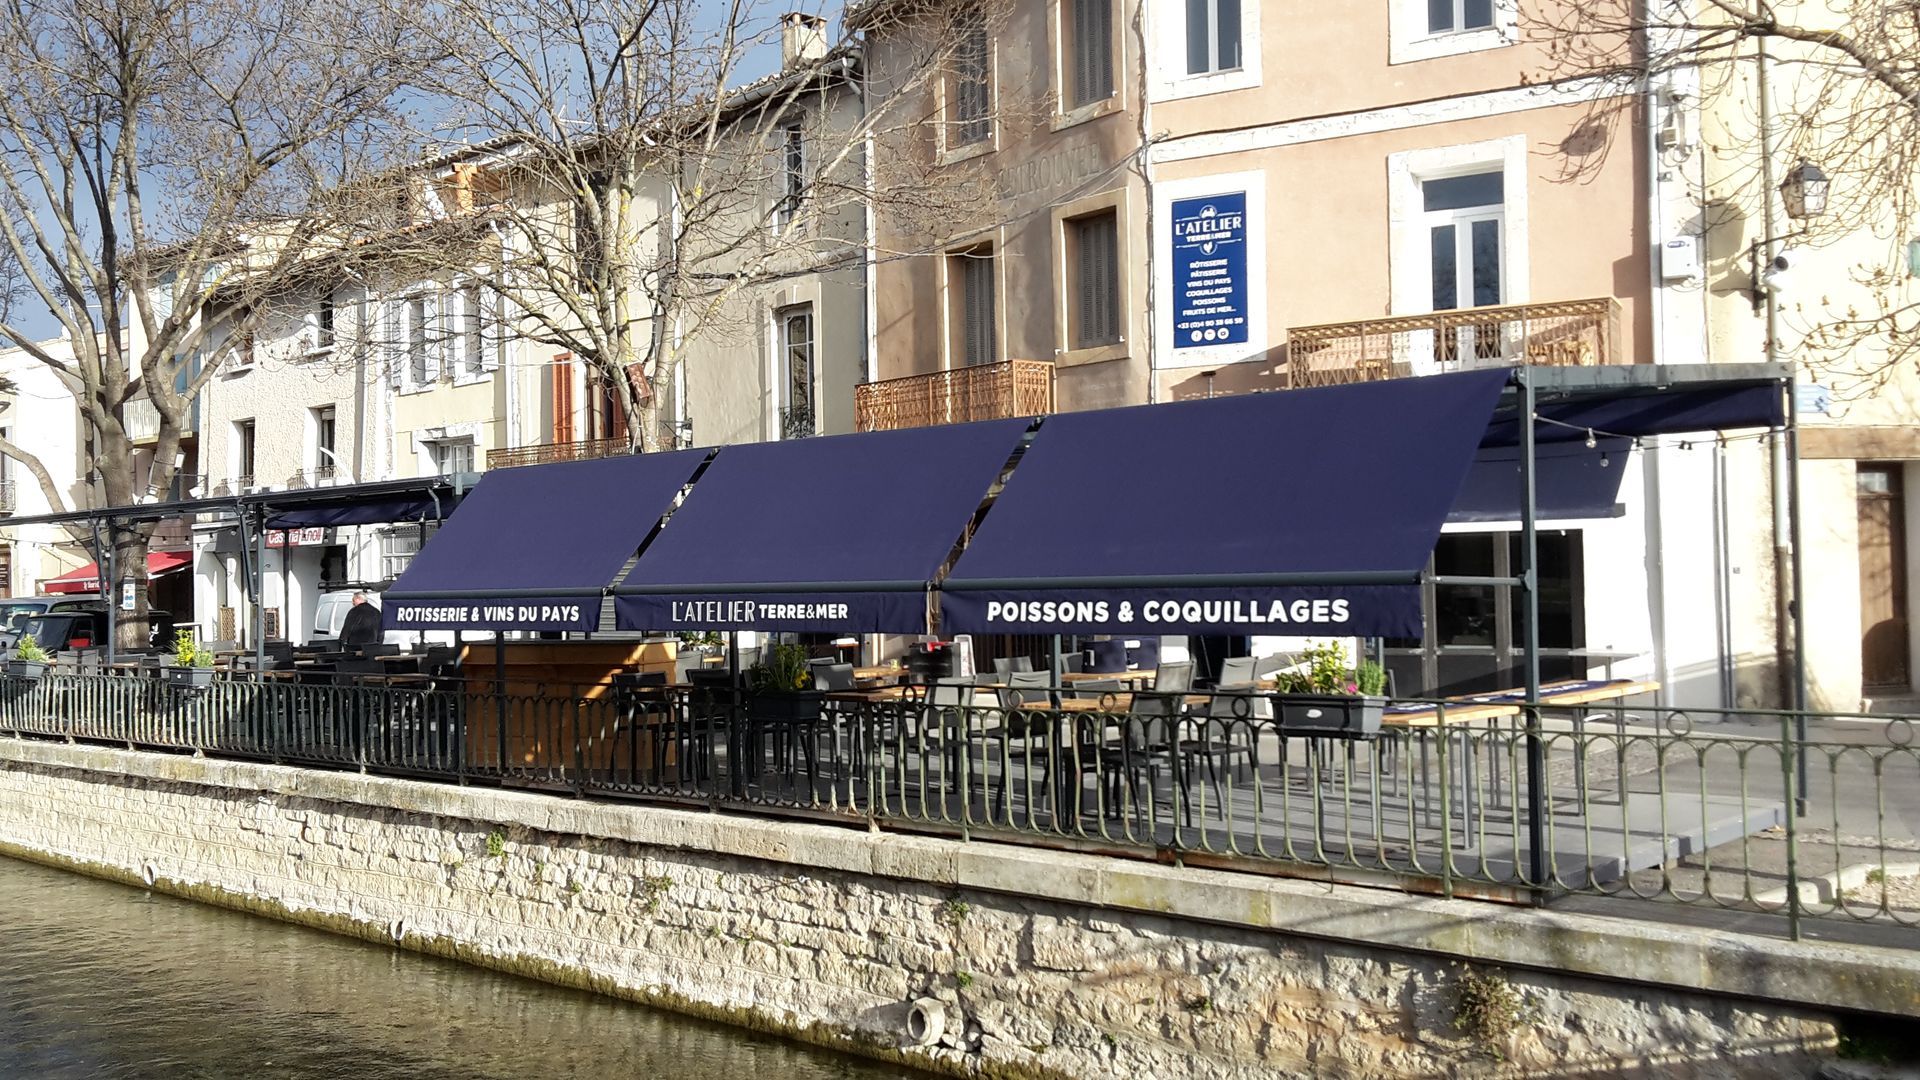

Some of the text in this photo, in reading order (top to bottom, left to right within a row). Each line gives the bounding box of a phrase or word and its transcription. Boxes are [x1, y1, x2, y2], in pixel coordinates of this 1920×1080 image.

[1175, 216, 1242, 236] L'ATELIER
[1186, 286, 1233, 297] COQUILLAGES
[397, 606, 580, 622] ROTISSERIE & VINS DU PAYS
[672, 601, 848, 622] L'ATELIER TERRE&MER
[987, 599, 1350, 623] POISSONS & COQUILLAGES
